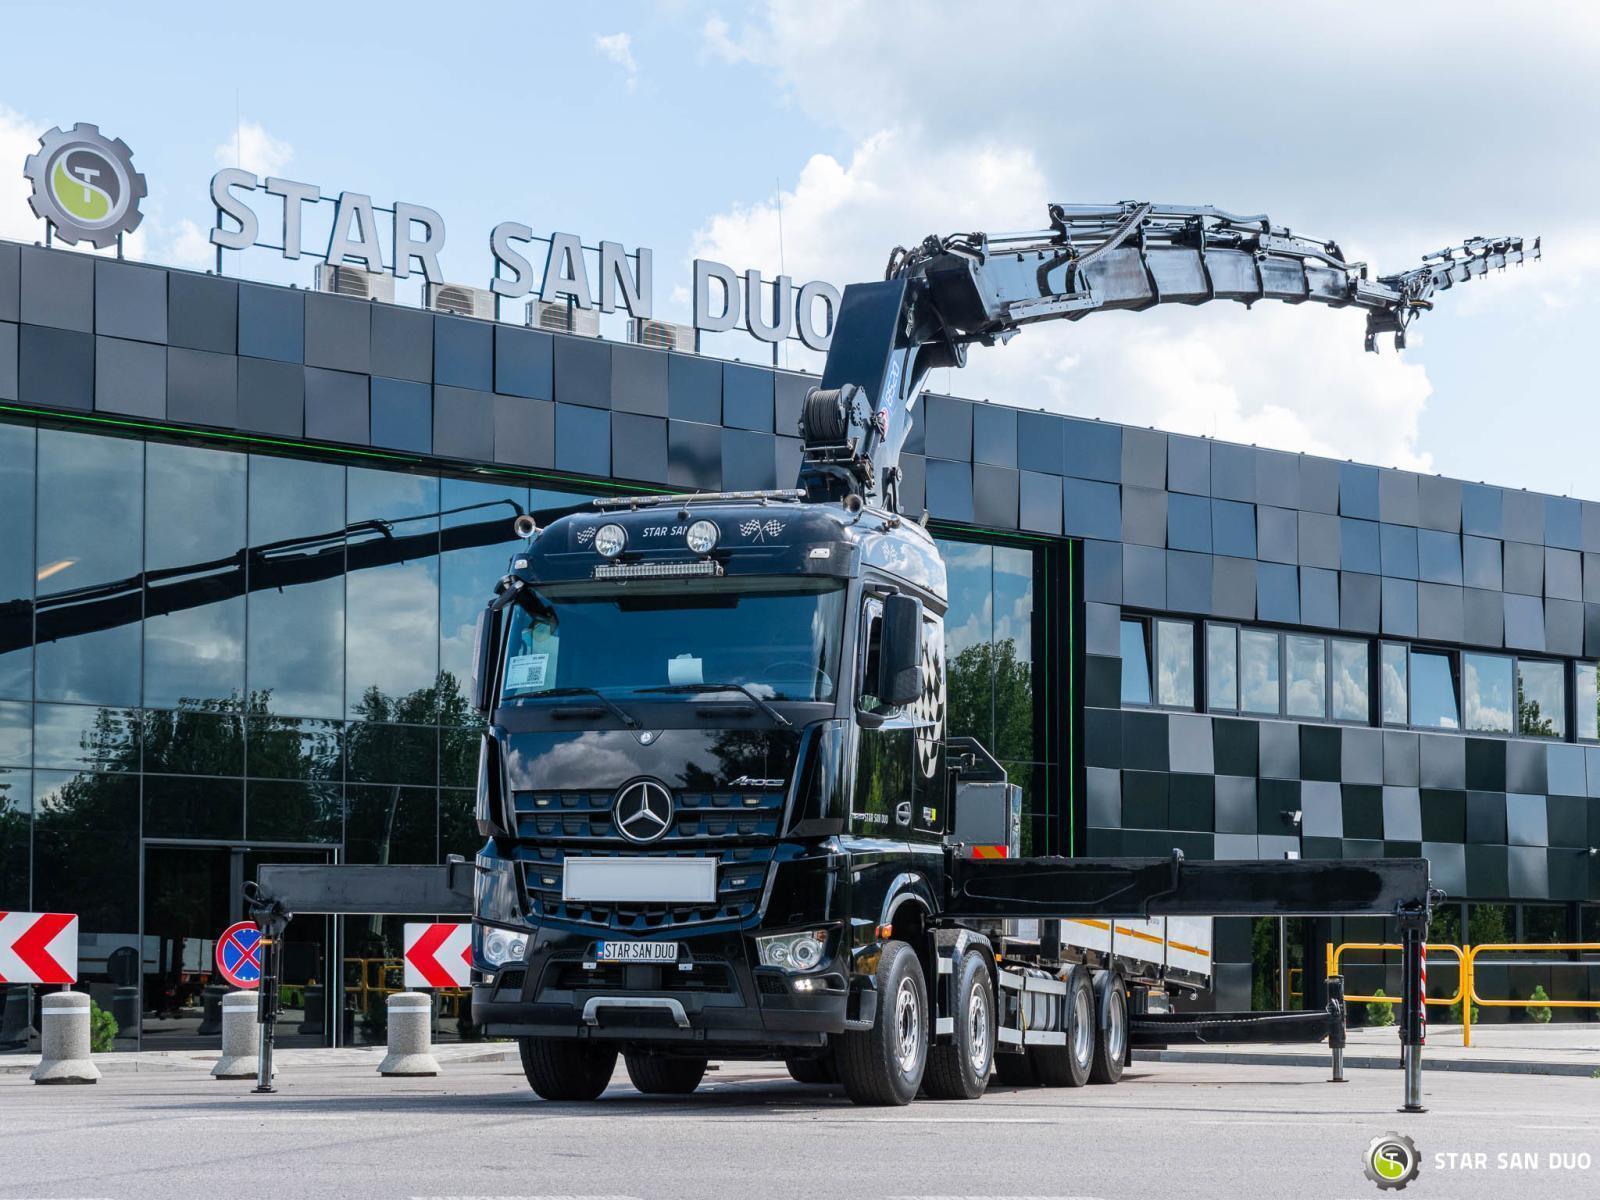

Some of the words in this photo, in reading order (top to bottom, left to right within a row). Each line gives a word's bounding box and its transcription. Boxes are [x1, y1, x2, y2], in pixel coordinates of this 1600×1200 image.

[210, 167, 445, 284] STAR
[490, 221, 653, 319] SAN
[693, 258, 842, 352] DUO
[642, 527, 668, 537] STAR
[605, 943, 630, 958] STAR
[632, 943, 652, 958] SAN
[655, 944, 675, 958] DUO
